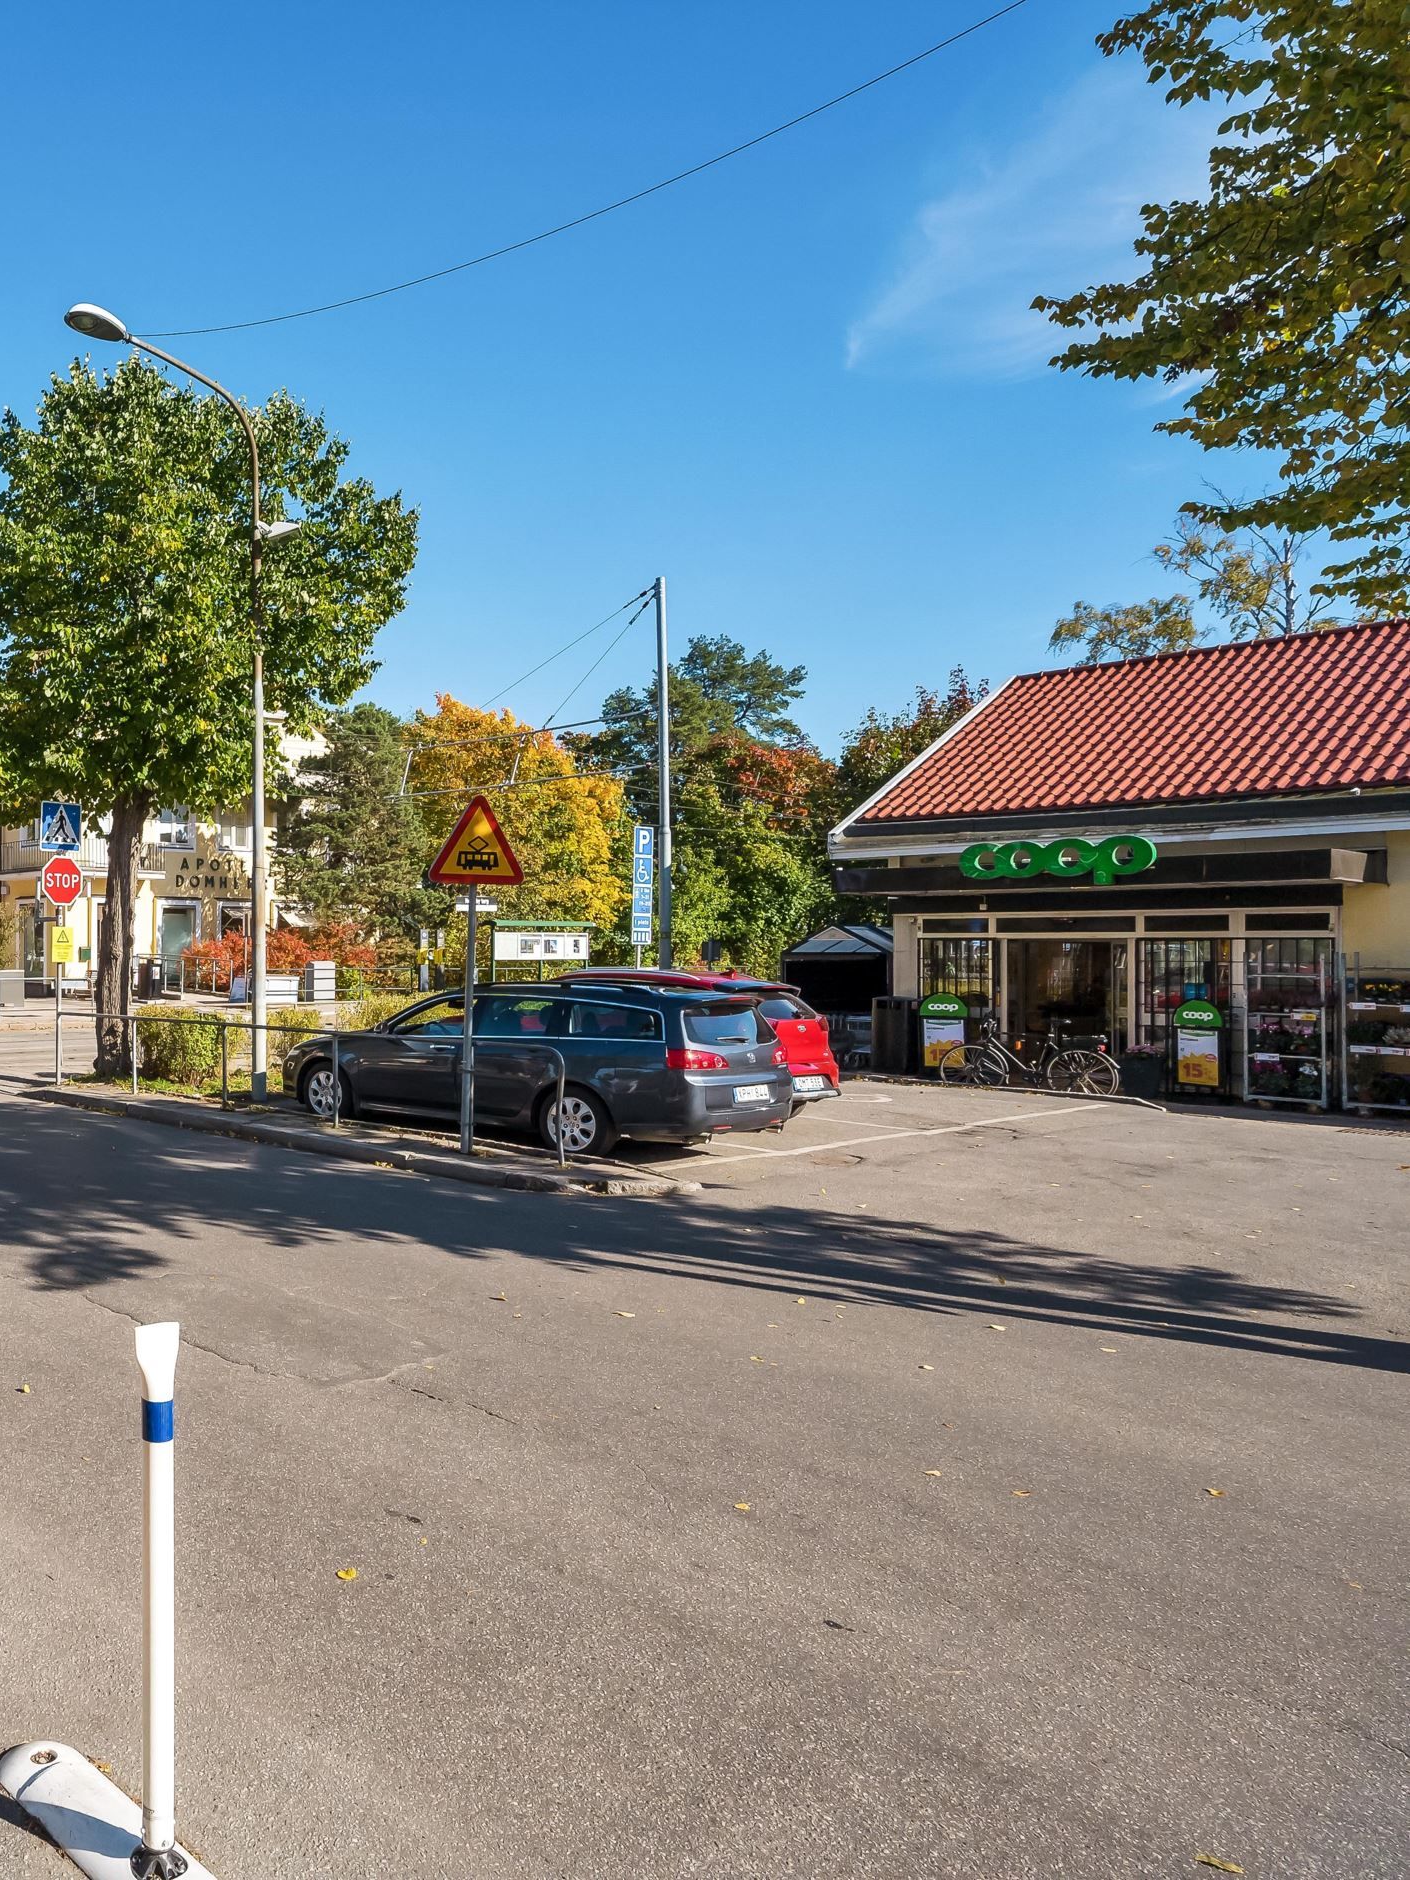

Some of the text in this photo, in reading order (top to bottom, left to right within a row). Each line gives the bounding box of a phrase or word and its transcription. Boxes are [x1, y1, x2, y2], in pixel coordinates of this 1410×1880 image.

[638, 829, 650, 853] P
[959, 834, 1156, 885] coop
[46, 872, 80, 888] STOP
[928, 1003, 959, 1012] coop
[1182, 1011, 1214, 1021] coop
[1183, 1062, 1203, 1078] 15
